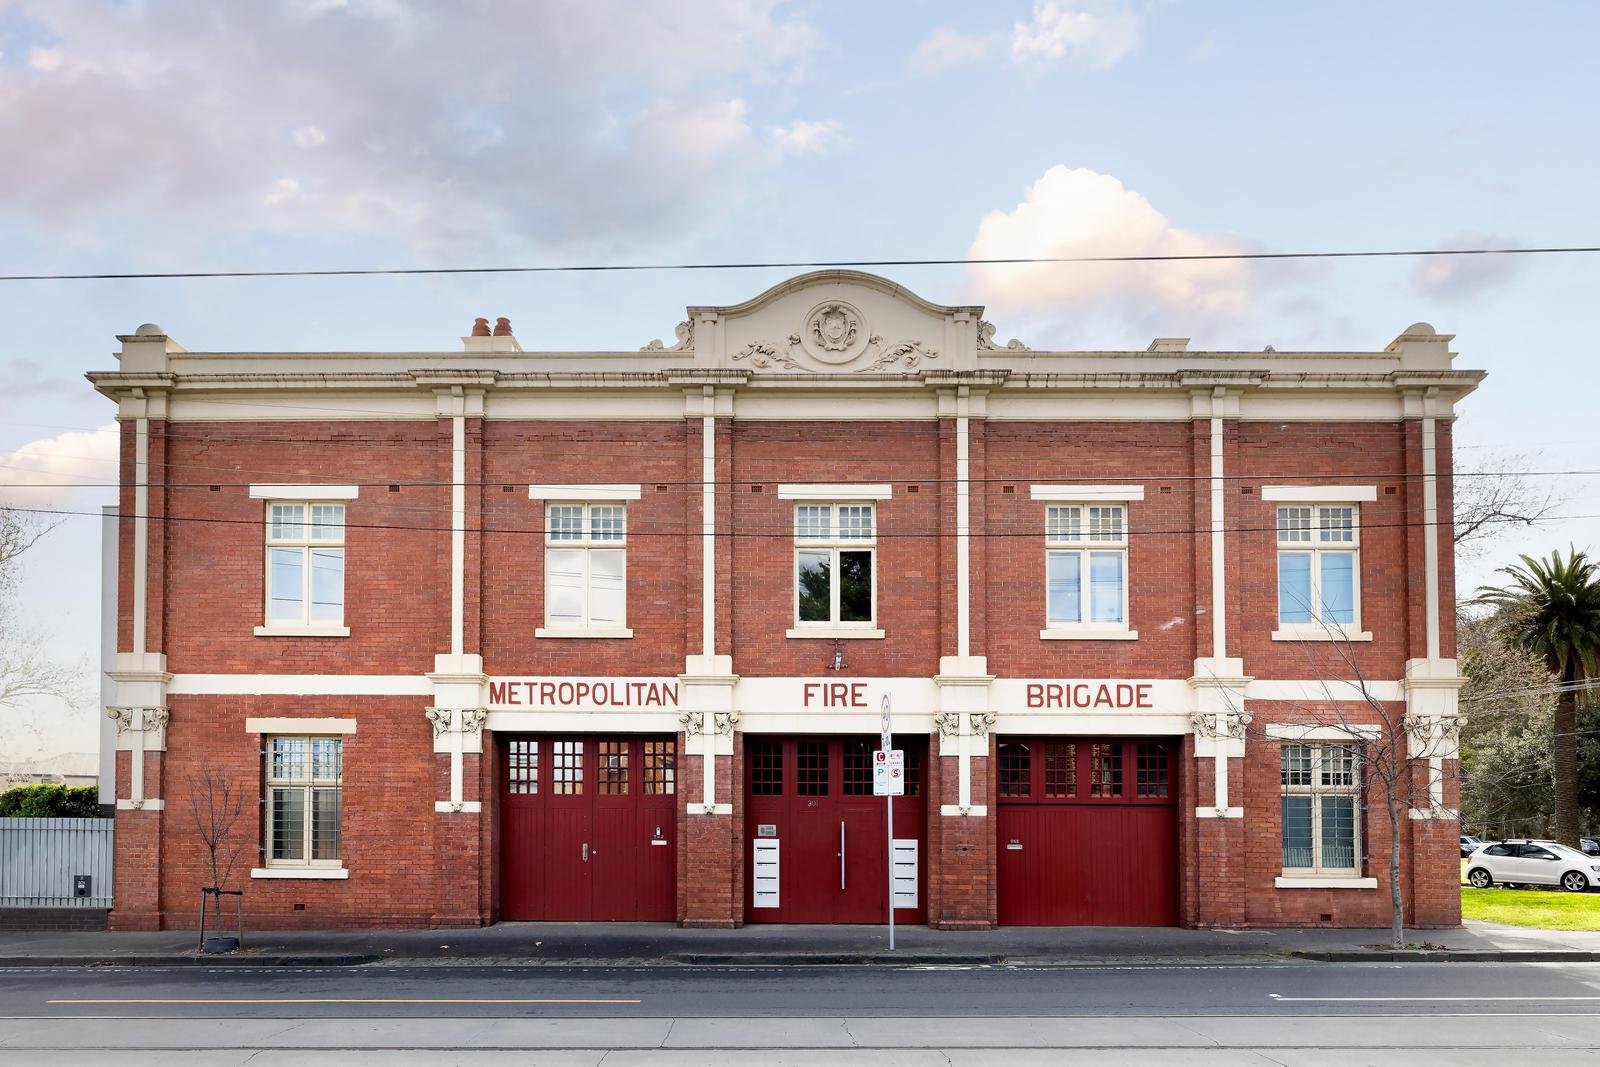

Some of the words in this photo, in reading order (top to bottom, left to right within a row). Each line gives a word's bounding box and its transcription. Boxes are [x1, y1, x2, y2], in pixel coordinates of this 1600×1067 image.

[489, 682, 678, 705] METROPOLITAN
[803, 683, 867, 707] FIRE
[1026, 684, 1153, 708] BRIGADE
